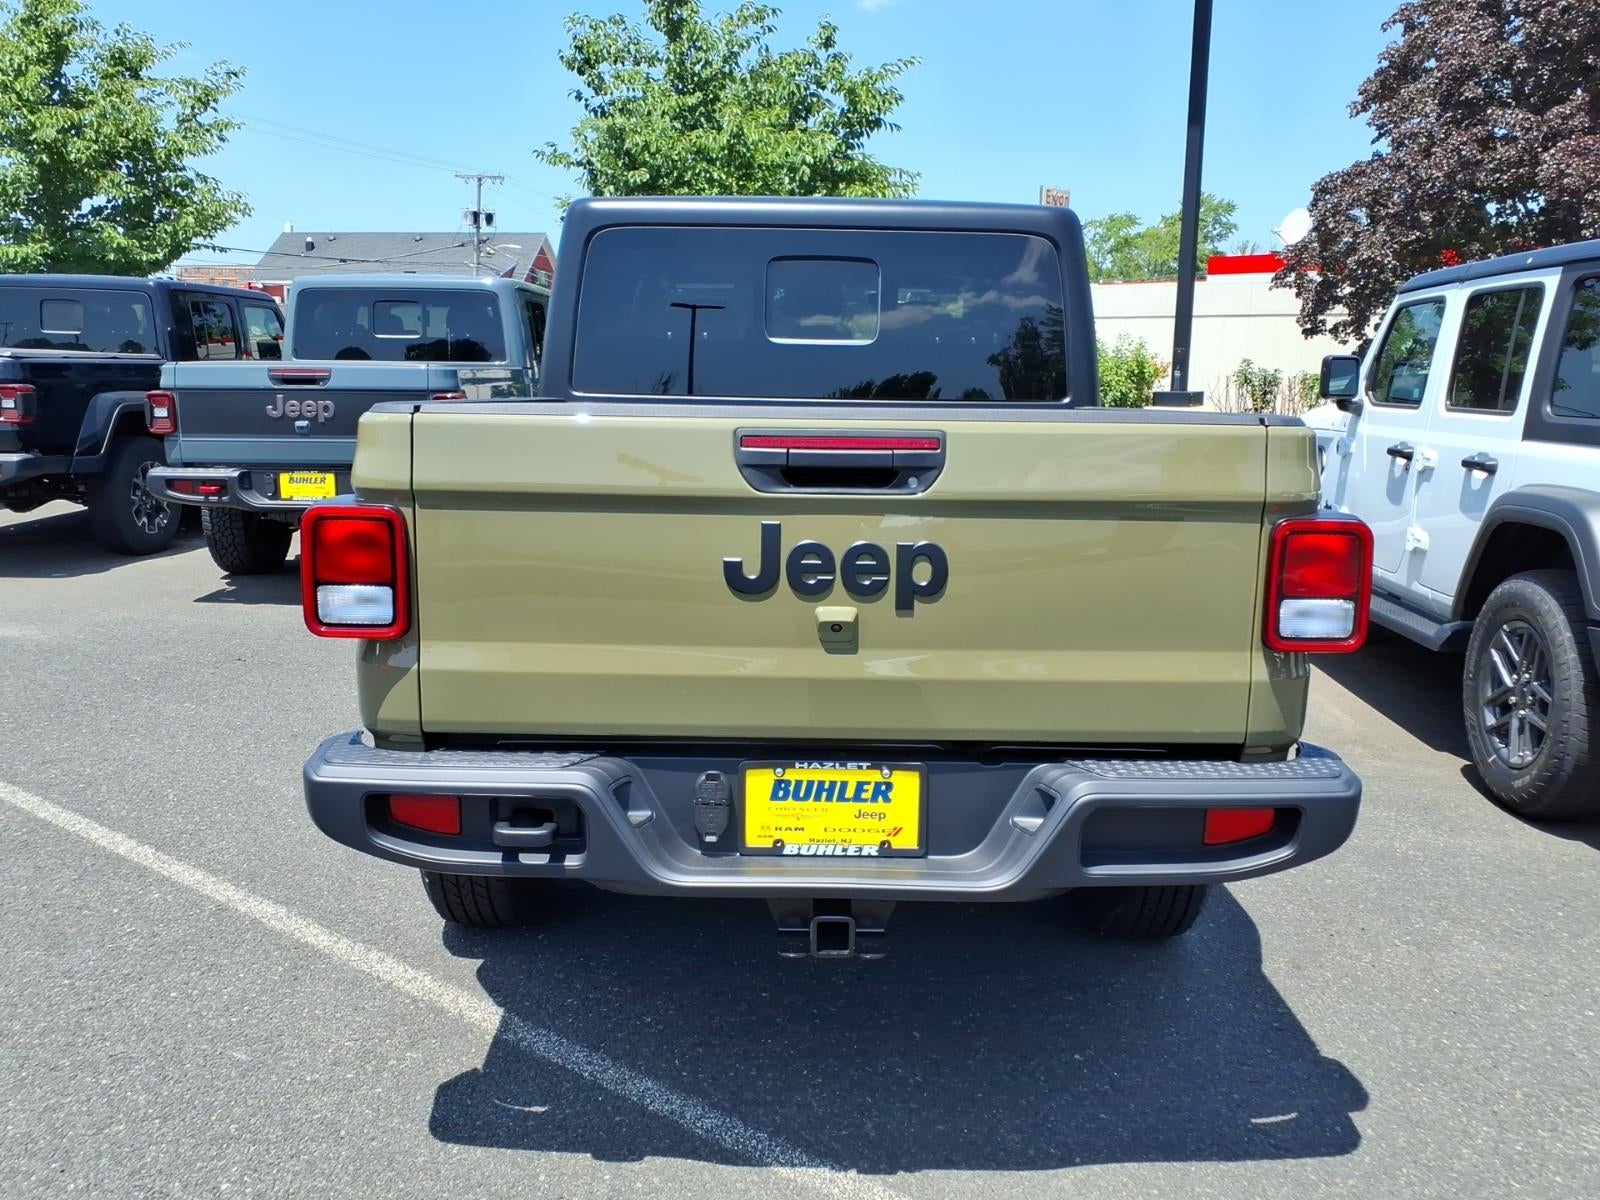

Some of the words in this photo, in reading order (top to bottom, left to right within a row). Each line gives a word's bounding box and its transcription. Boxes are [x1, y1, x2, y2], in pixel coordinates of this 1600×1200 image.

[266, 395, 335, 422] Jeep
[288, 476, 326, 484] BUHLER
[722, 520, 949, 612] Jeep
[794, 762, 871, 770] HAZLET
[769, 779, 894, 803] BUHLER
[854, 809, 886, 821] Jeep
[782, 844, 879, 856] BUHLER
